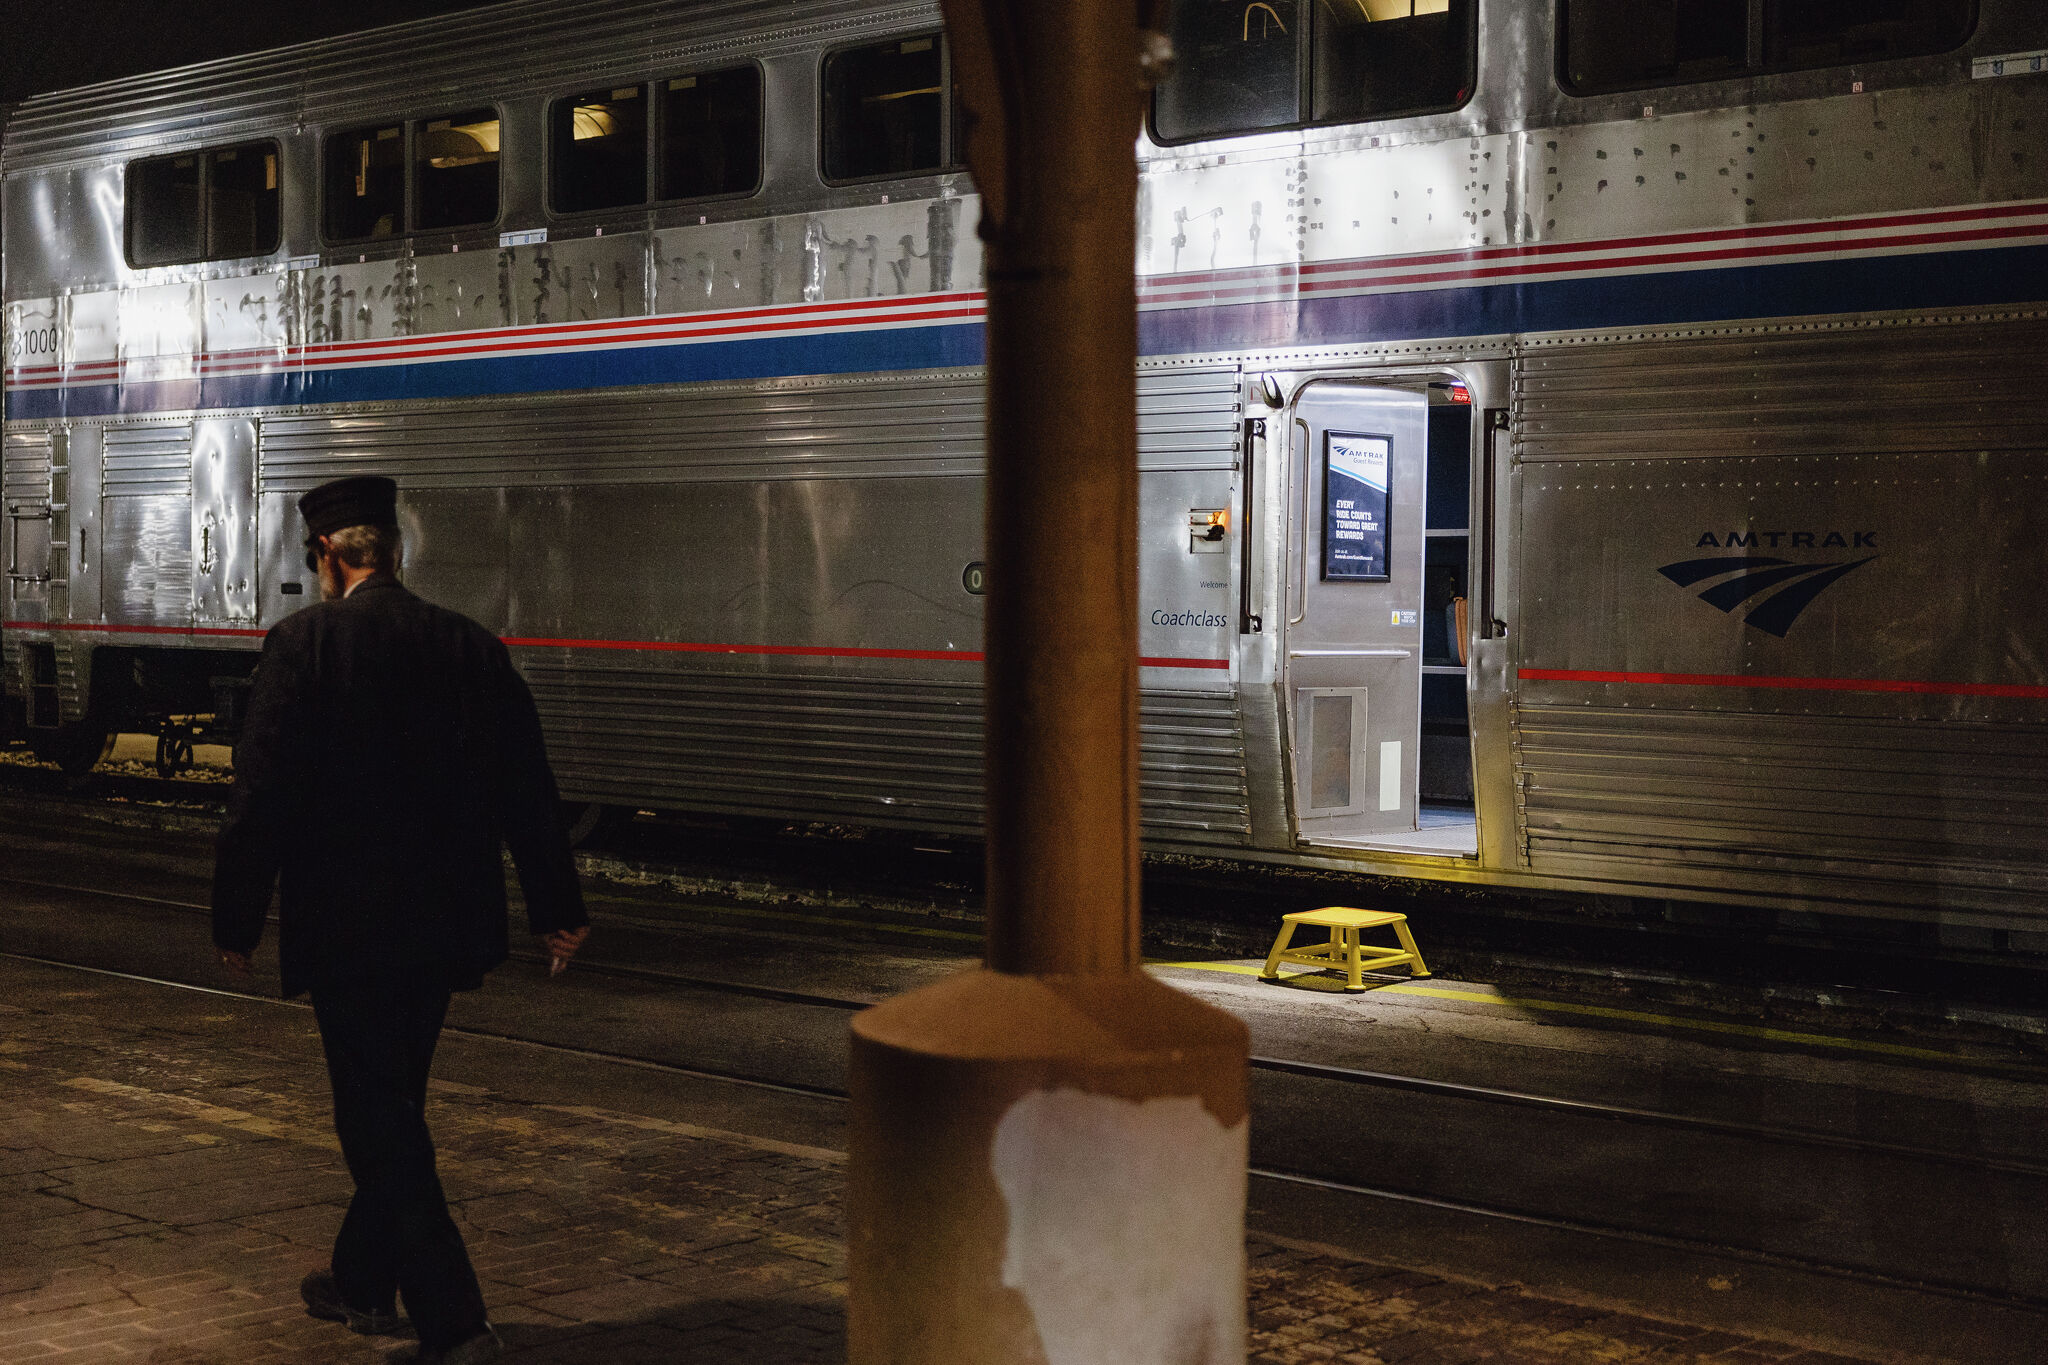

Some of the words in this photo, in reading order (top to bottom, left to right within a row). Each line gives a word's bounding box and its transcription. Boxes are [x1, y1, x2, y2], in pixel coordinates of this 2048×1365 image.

[1348, 450, 1384, 459] AMTRAK
[1336, 500, 1354, 509] EVERY
[1336, 510, 1350, 519] RIDE
[1350, 511, 1372, 521] COUNTS
[1336, 520, 1360, 530] TOWARD
[1361, 521, 1379, 531] GREAT
[1336, 531, 1364, 540] REWARDS
[1695, 531, 1878, 548] AMTRAK
[1199, 580, 1229, 589] Welcome
[1151, 609, 1228, 627] Coachclass
